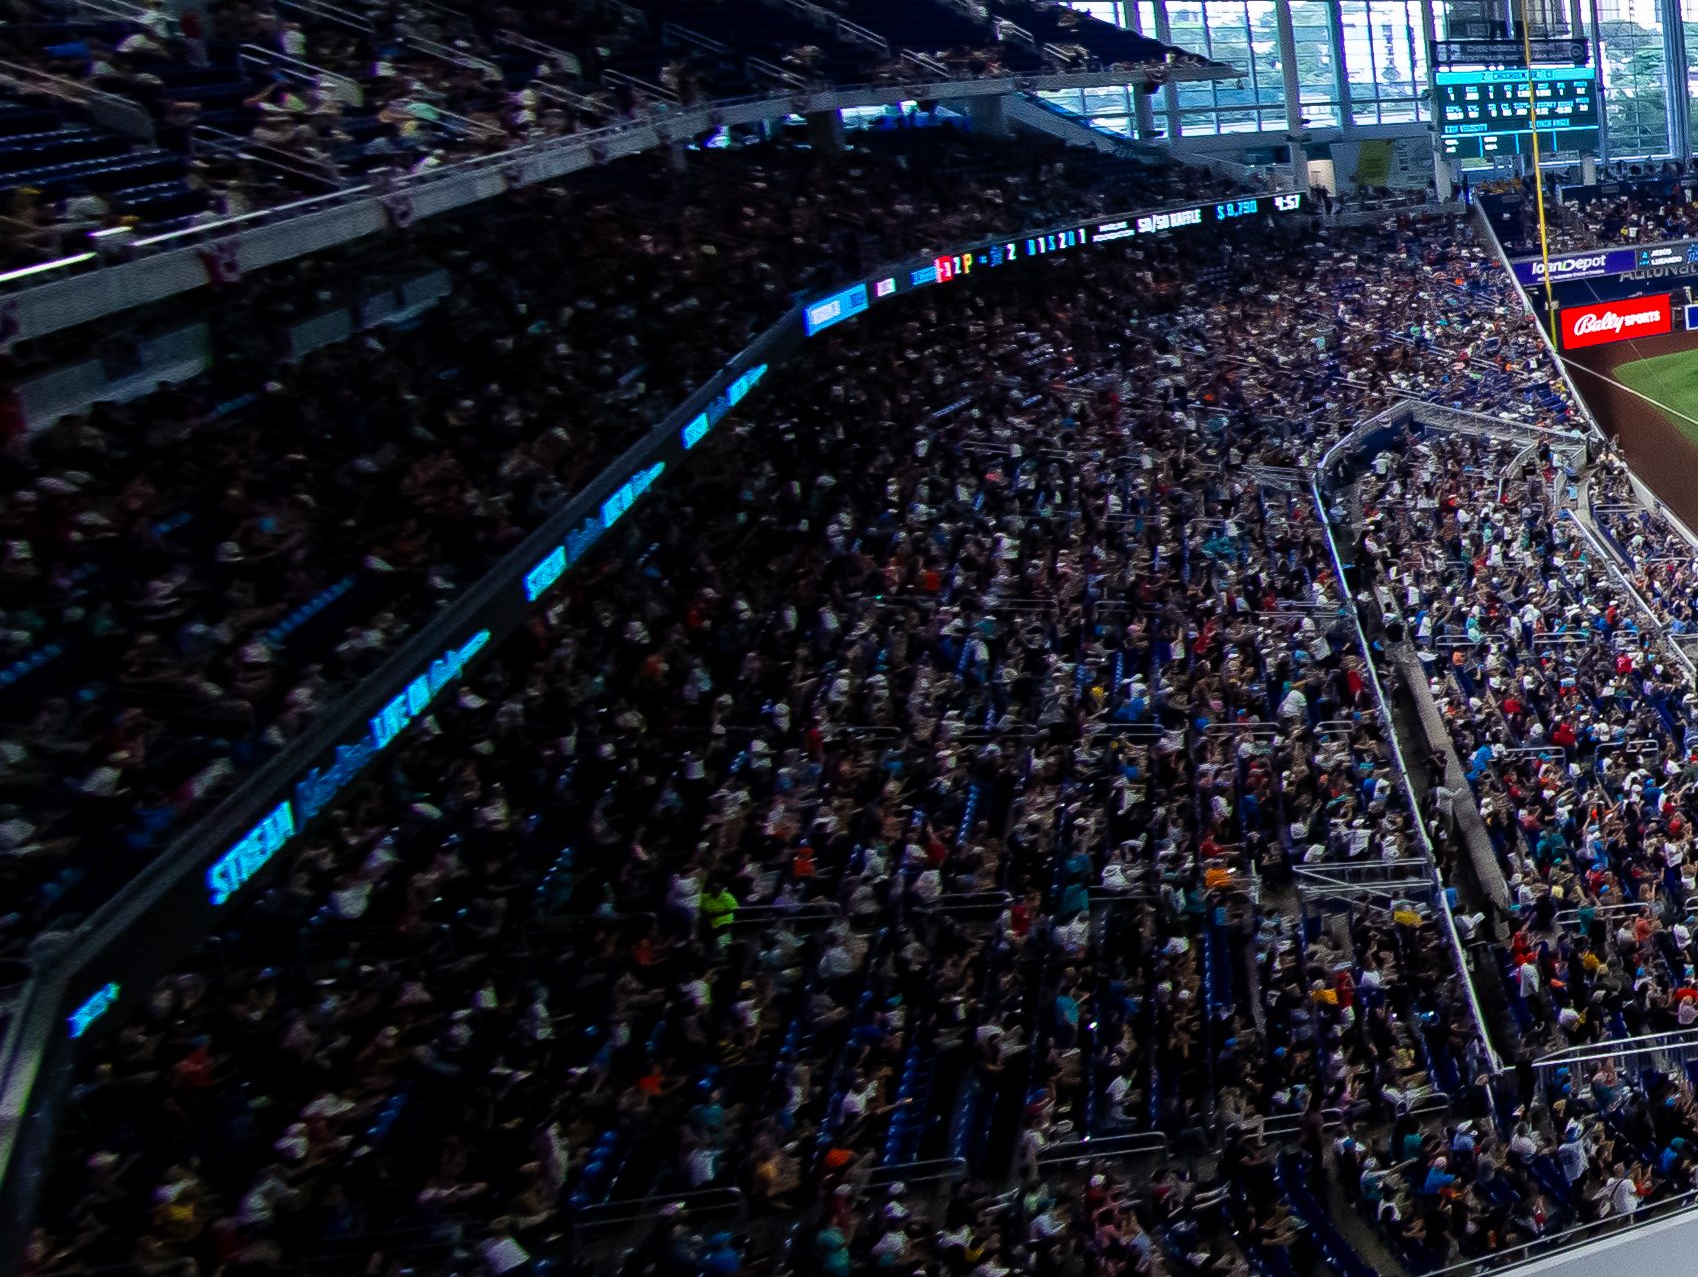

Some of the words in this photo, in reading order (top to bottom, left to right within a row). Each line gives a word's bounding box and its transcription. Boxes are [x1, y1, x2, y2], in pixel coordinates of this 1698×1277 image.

[1532, 255, 1606, 275] loanDepot
[1574, 311, 1624, 336] Bally
[1624, 310, 1661, 327] SPORTS
